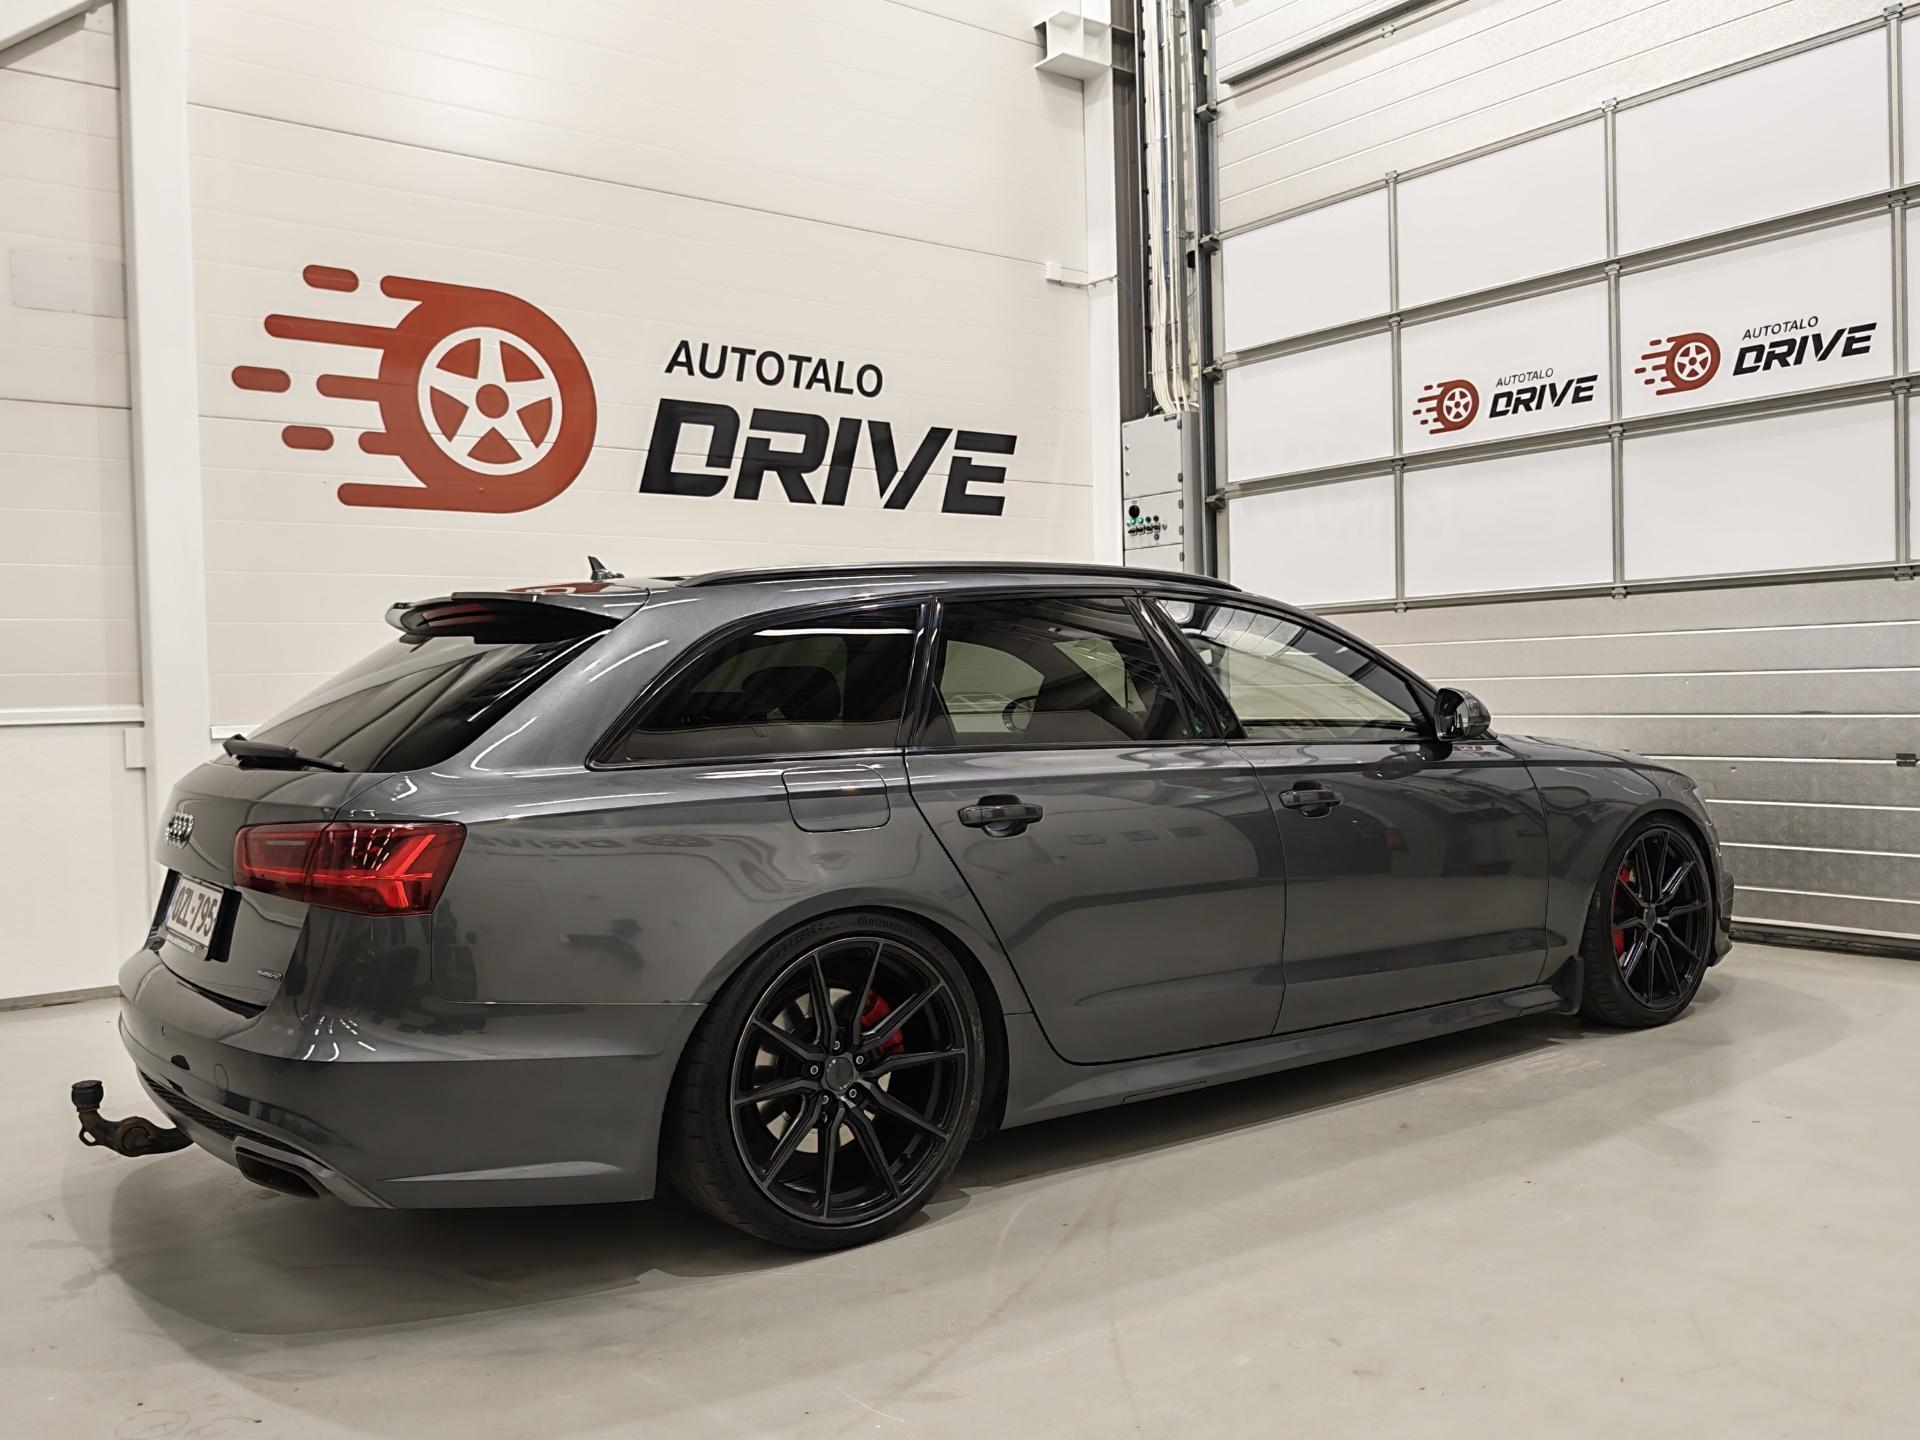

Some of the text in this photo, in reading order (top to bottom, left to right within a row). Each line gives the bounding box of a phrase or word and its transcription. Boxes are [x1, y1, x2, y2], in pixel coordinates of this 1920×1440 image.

[1733, 323, 1877, 376] DRIVE
[1743, 316, 1818, 340] AUTOTALO
[665, 340, 883, 398] AUTOTALO
[1496, 368, 1554, 387] AUTOTALO
[1489, 375, 1598, 418] DRIVE
[639, 398, 1018, 516] DRIVE
[172, 886, 218, 937] OZL-795
